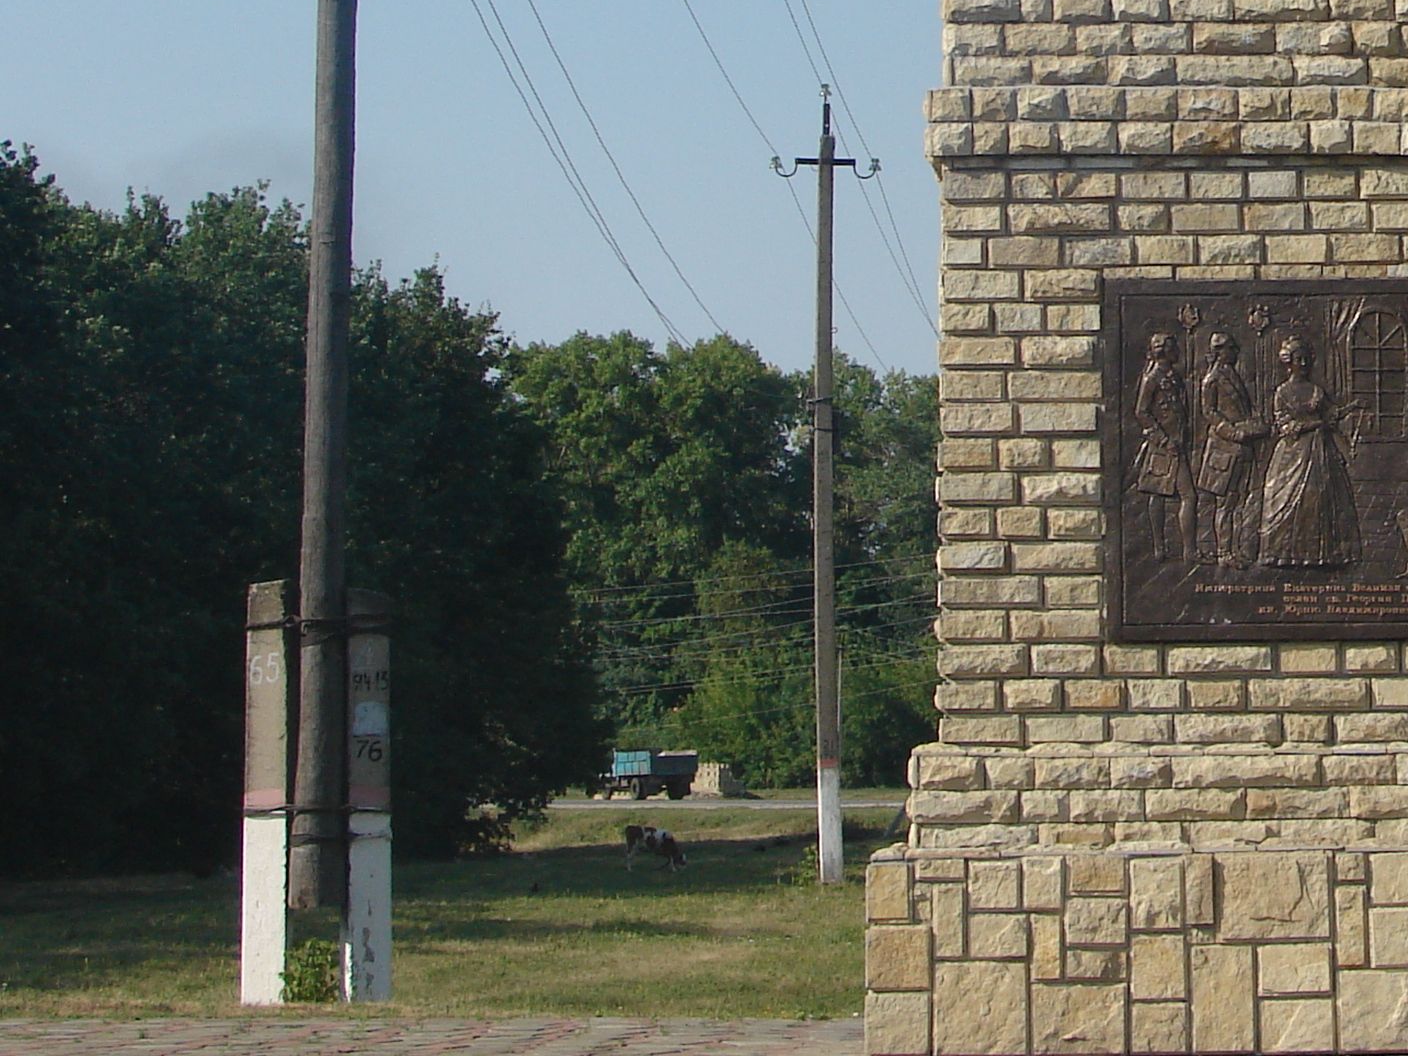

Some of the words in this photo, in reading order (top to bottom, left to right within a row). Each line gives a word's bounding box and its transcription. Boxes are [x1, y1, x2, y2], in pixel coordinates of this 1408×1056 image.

[1283, 583, 1346, 594] Екатерина
[1284, 604, 1321, 616] Юрию
[250, 651, 280, 684] 65
[356, 740, 383, 762] 76
